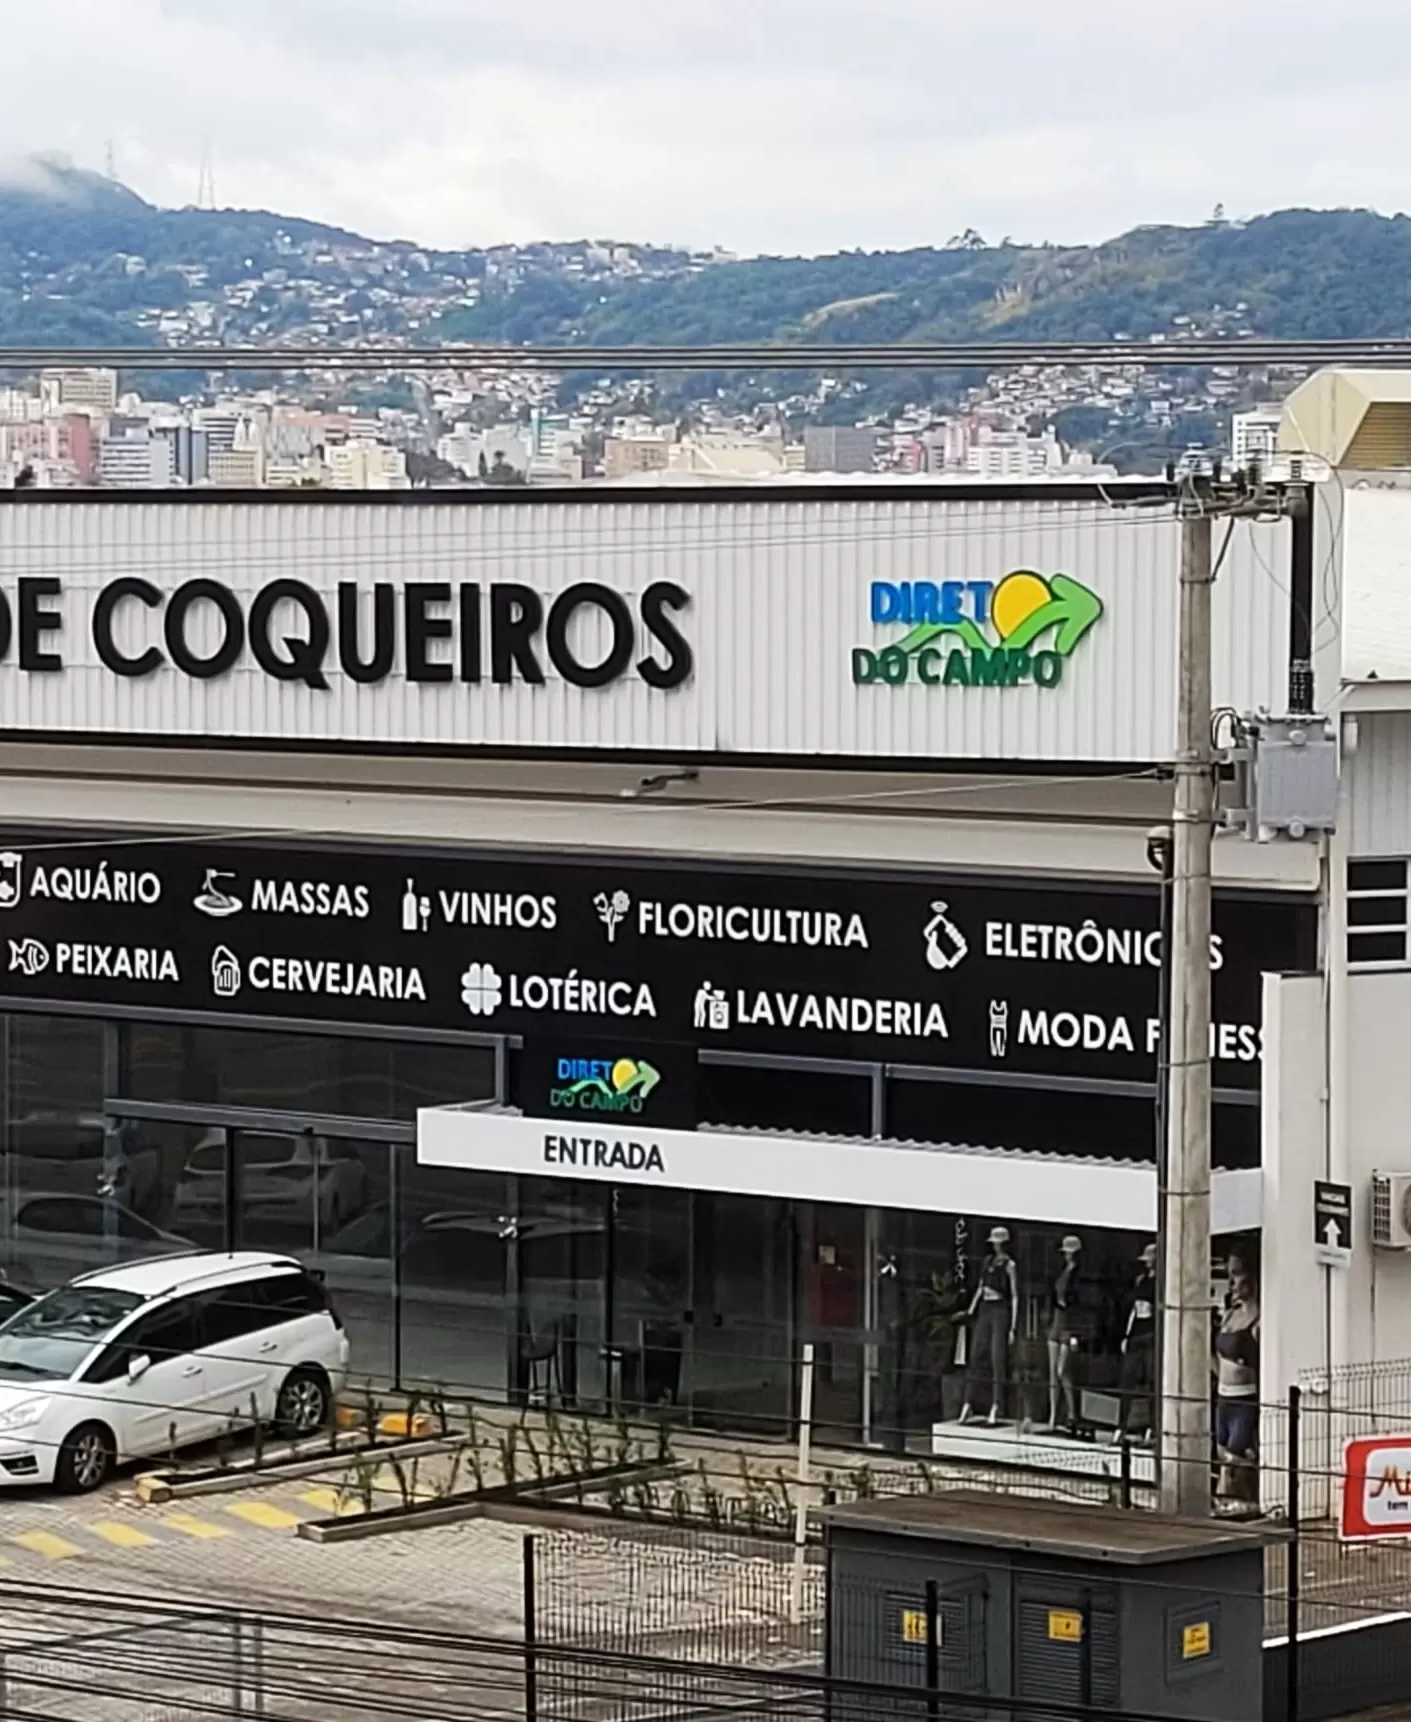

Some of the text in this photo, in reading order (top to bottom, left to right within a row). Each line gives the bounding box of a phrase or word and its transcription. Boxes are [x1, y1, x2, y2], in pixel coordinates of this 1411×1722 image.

[92, 577, 694, 691] COQUEIROS
[851, 647, 1063, 688] DO CAMPO
[30, 860, 162, 904] AQUÁRIO
[251, 879, 370, 918] MASSAS
[439, 890, 558, 929] VINHOS
[638, 901, 869, 949] FLORICULTURA
[55, 942, 180, 982] PEIXARIA
[986, 919, 1224, 971] ELETRÔNICS
[248, 956, 427, 1002] CERVEJARIA
[510, 968, 657, 1018] LOTÉRICA
[737, 989, 949, 1039] LAVANDERIA
[1017, 1009, 1135, 1052] MODA
[549, 1088, 643, 1113] DO CAMPO
[544, 1135, 665, 1173] ENTRADA
